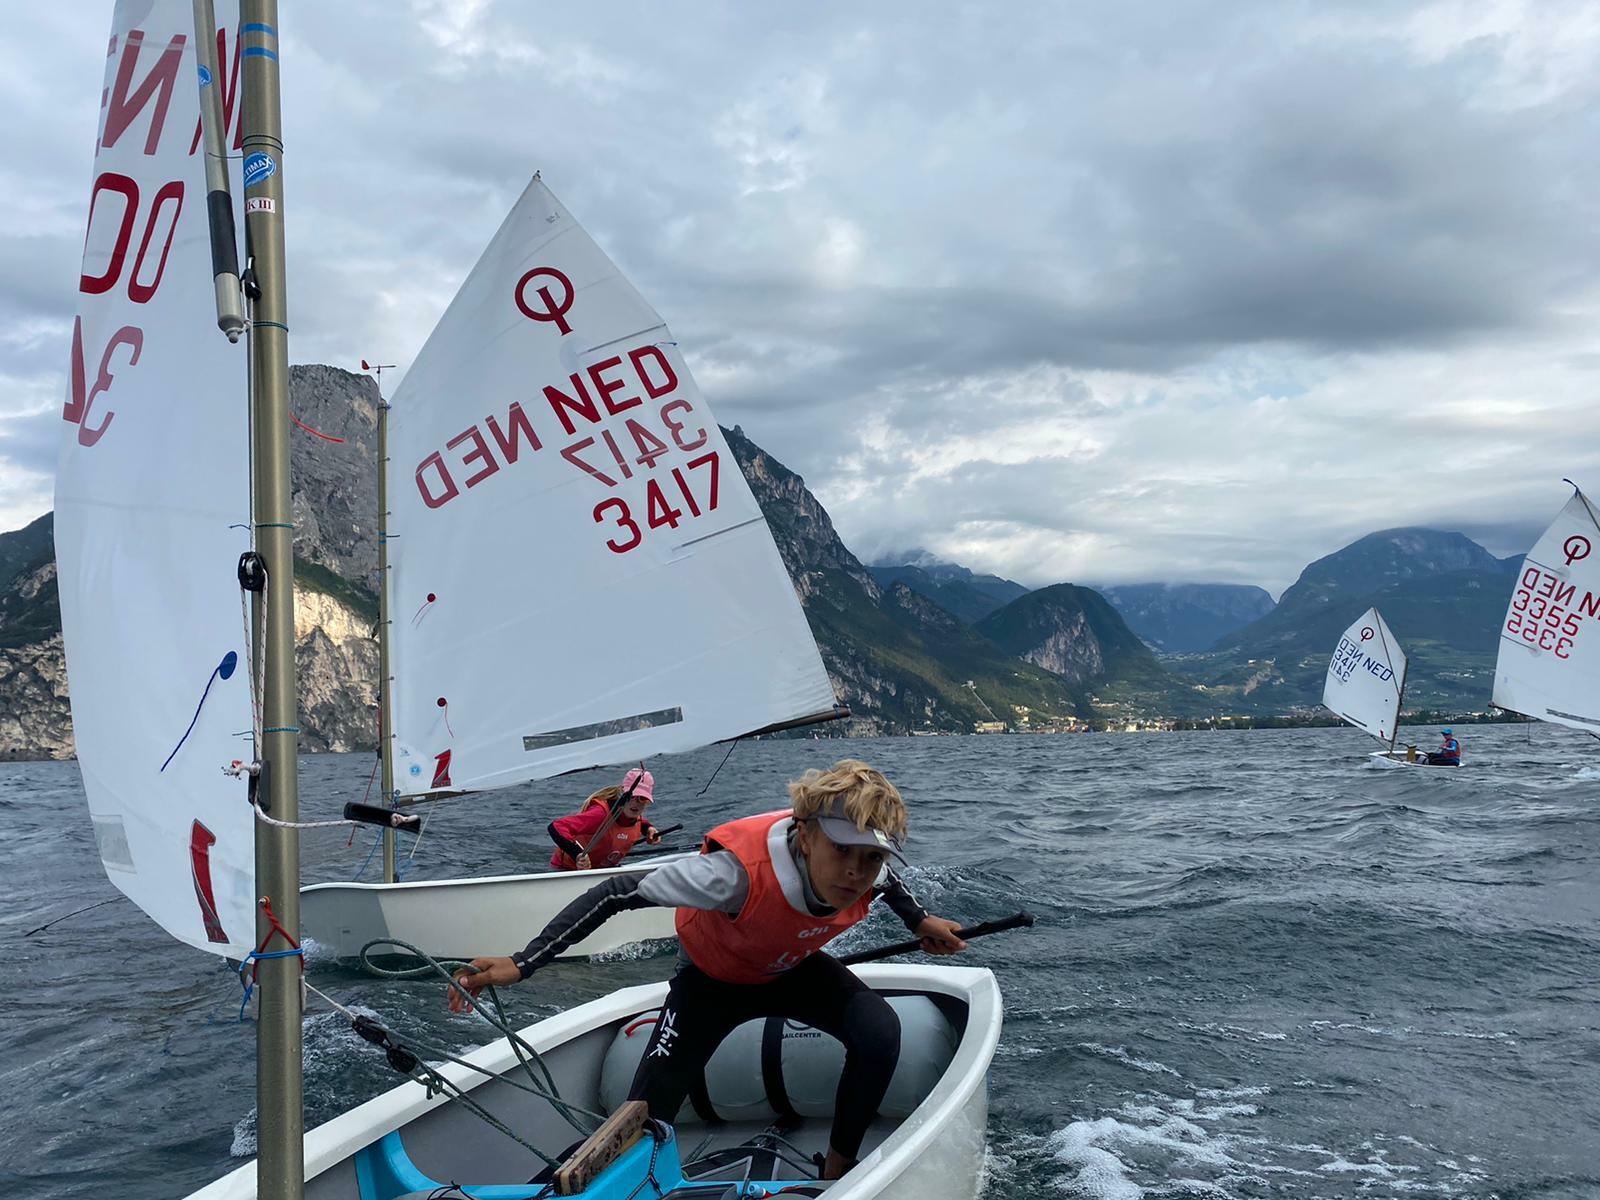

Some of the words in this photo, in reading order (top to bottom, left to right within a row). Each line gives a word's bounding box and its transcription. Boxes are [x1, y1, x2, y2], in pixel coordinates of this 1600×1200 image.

[245, 157, 272, 176] TIMAX
[542, 344, 679, 436] NED
[592, 451, 719, 554] 3417
[1512, 589, 1583, 637] 3355
[1334, 648, 1357, 673] 3411
[1362, 657, 1394, 682] NED
[649, 1008, 679, 1057] Zhik
